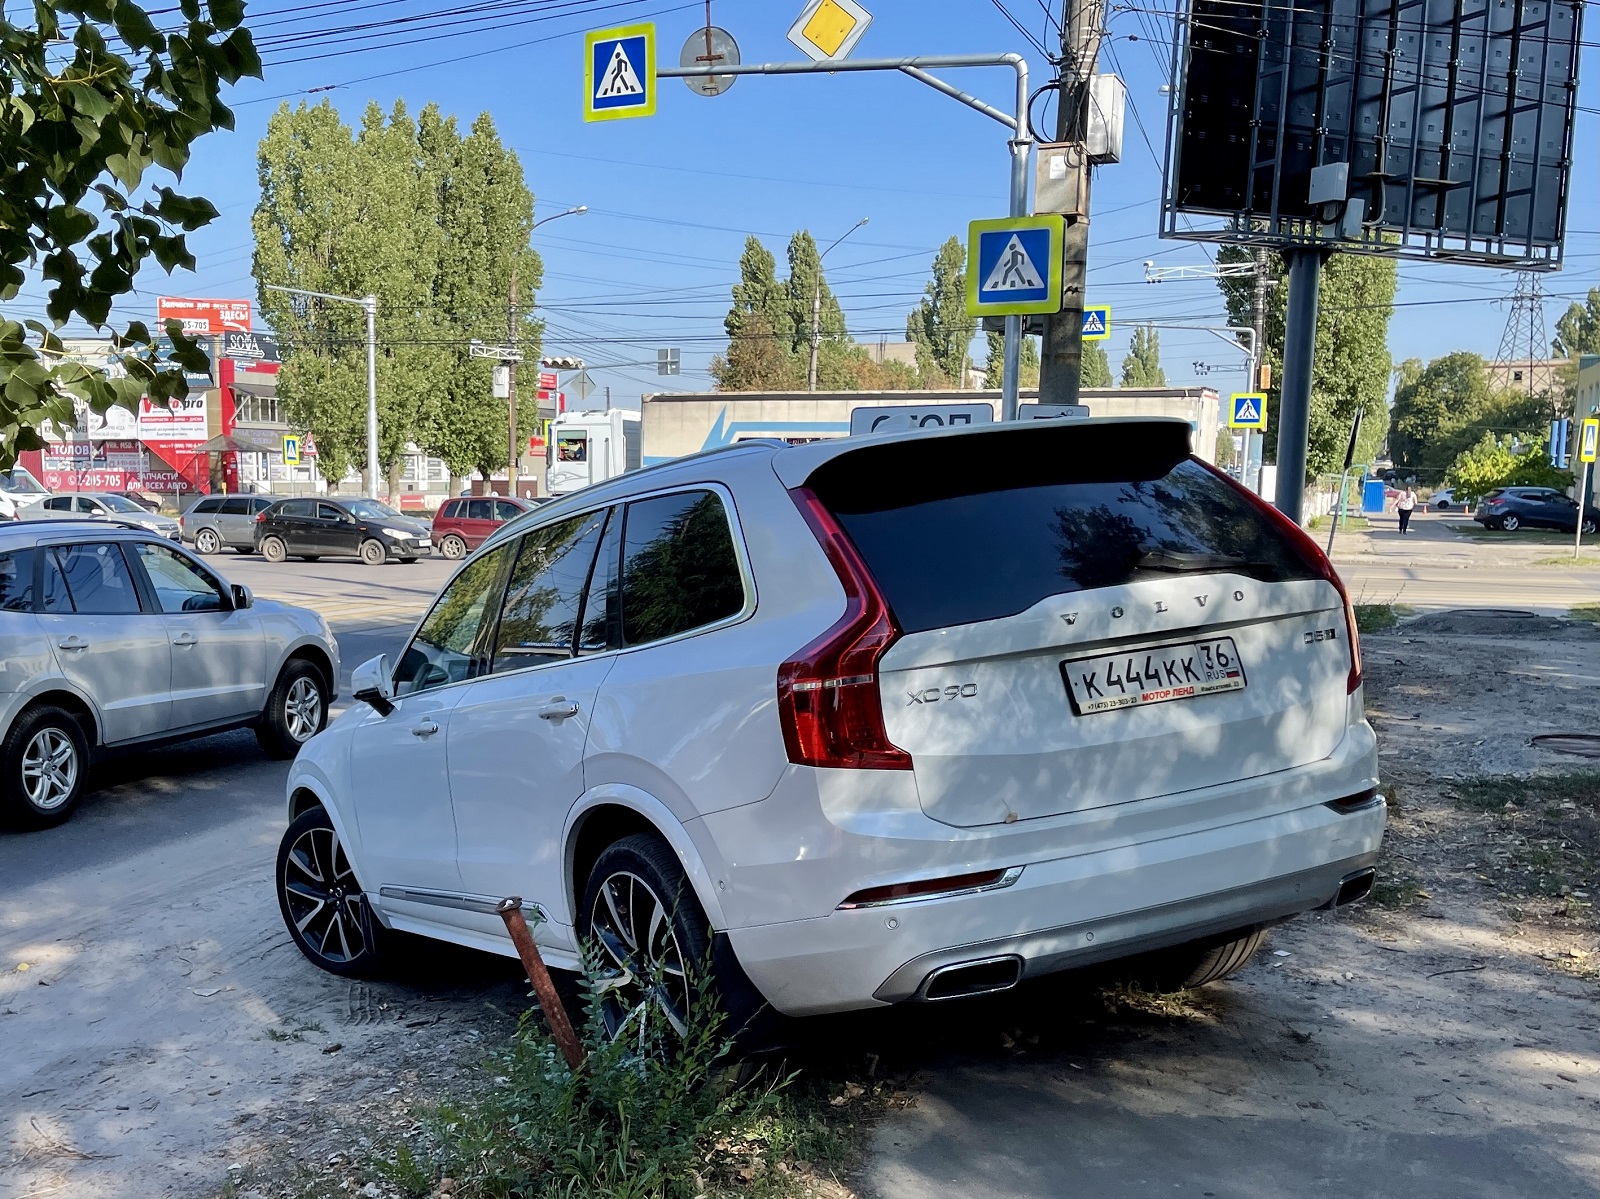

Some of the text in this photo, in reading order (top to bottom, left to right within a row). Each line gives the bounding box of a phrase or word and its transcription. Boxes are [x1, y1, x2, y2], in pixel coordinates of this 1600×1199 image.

[161, 299, 194, 309] Запчасти
[196, 301, 210, 310] для
[219, 310, 248, 321] ЗДЕСЬ!
[145, 481, 164, 490] ВСЕХ
[1060, 590, 1244, 625] VOLVO
[1200, 643, 1230, 670] 36
[1206, 669, 1226, 681] RUS
[1141, 686, 1195, 702] МОТОР ЛЕНД
